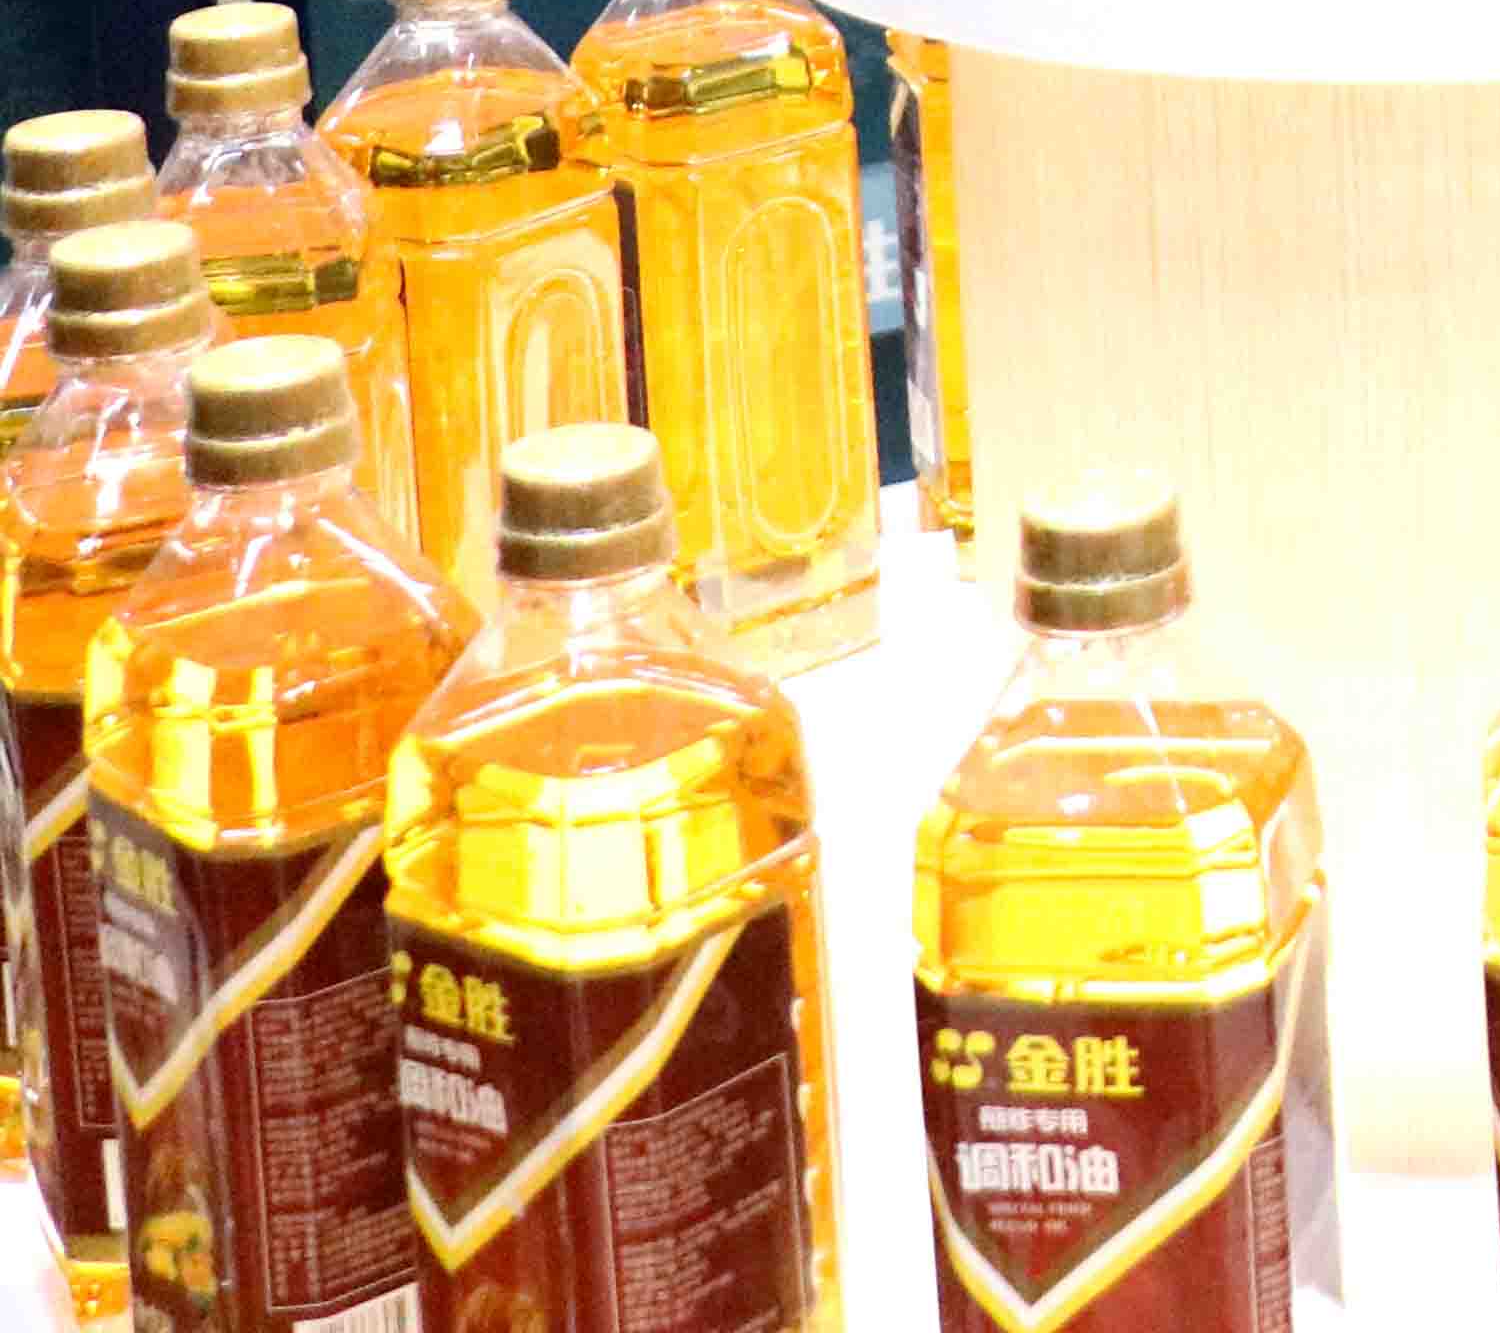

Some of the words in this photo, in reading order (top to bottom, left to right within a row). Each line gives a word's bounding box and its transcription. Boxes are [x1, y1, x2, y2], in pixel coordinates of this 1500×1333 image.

[420, 963, 516, 1045] 金胜
[1005, 1034, 1146, 1097] 金胜
[956, 1141, 1120, 1196] 调和油
